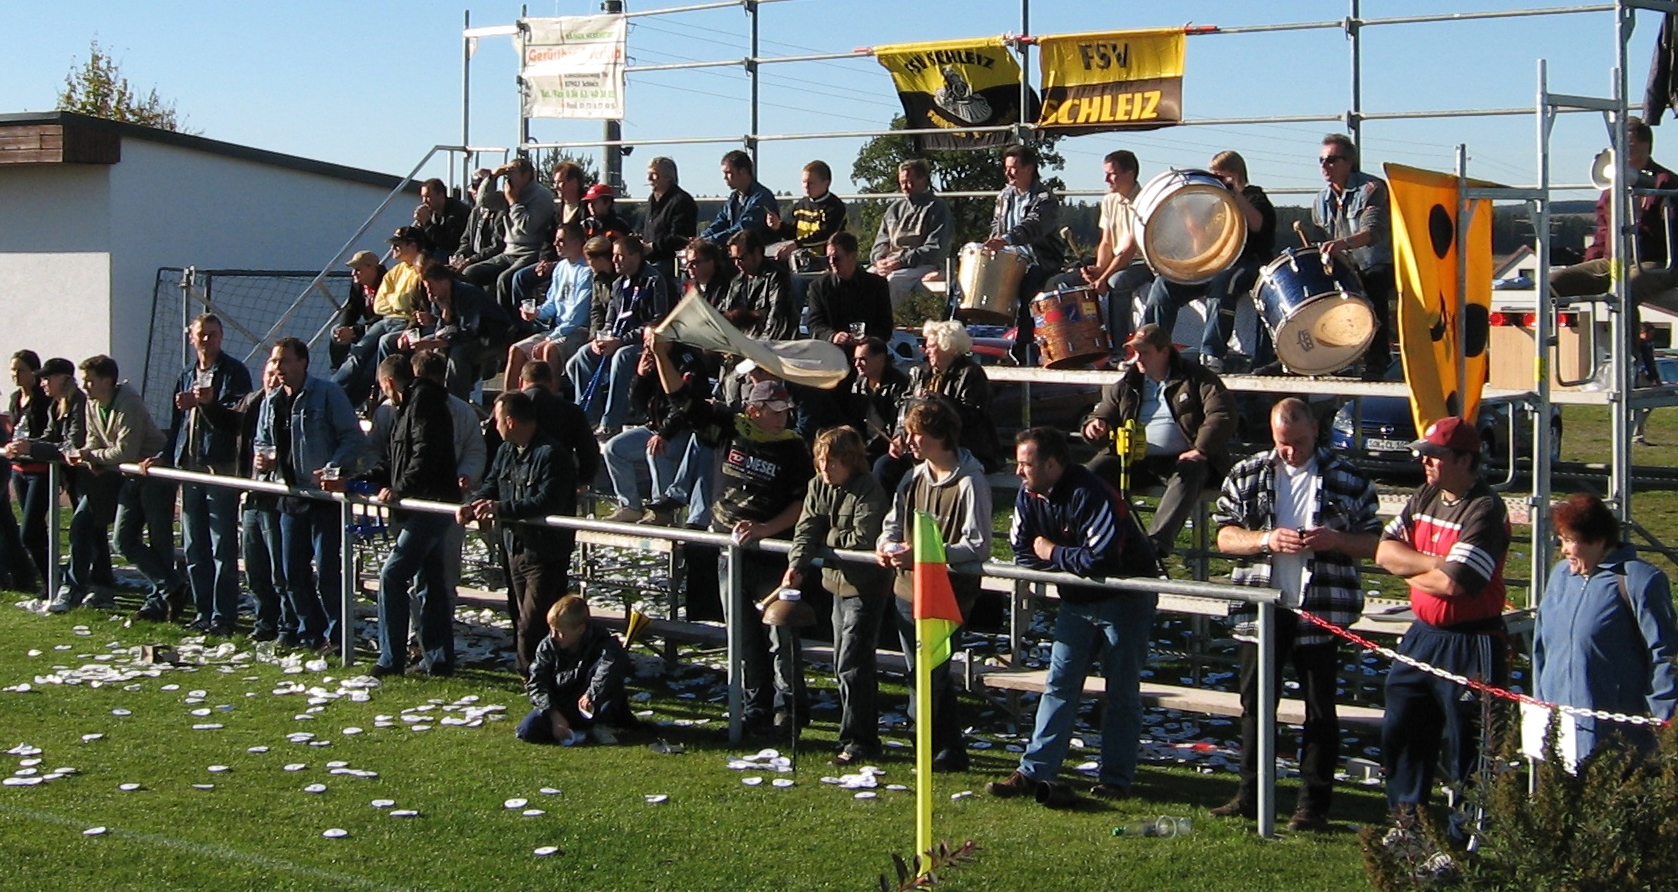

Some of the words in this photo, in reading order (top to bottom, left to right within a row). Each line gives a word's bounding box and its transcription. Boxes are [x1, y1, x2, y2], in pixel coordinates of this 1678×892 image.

[927, 50, 996, 70] SCHLEIZ
[1079, 42, 1128, 70] FSV
[1041, 90, 1161, 126] SCHLEIZ
[745, 455, 777, 477] DIESEL
